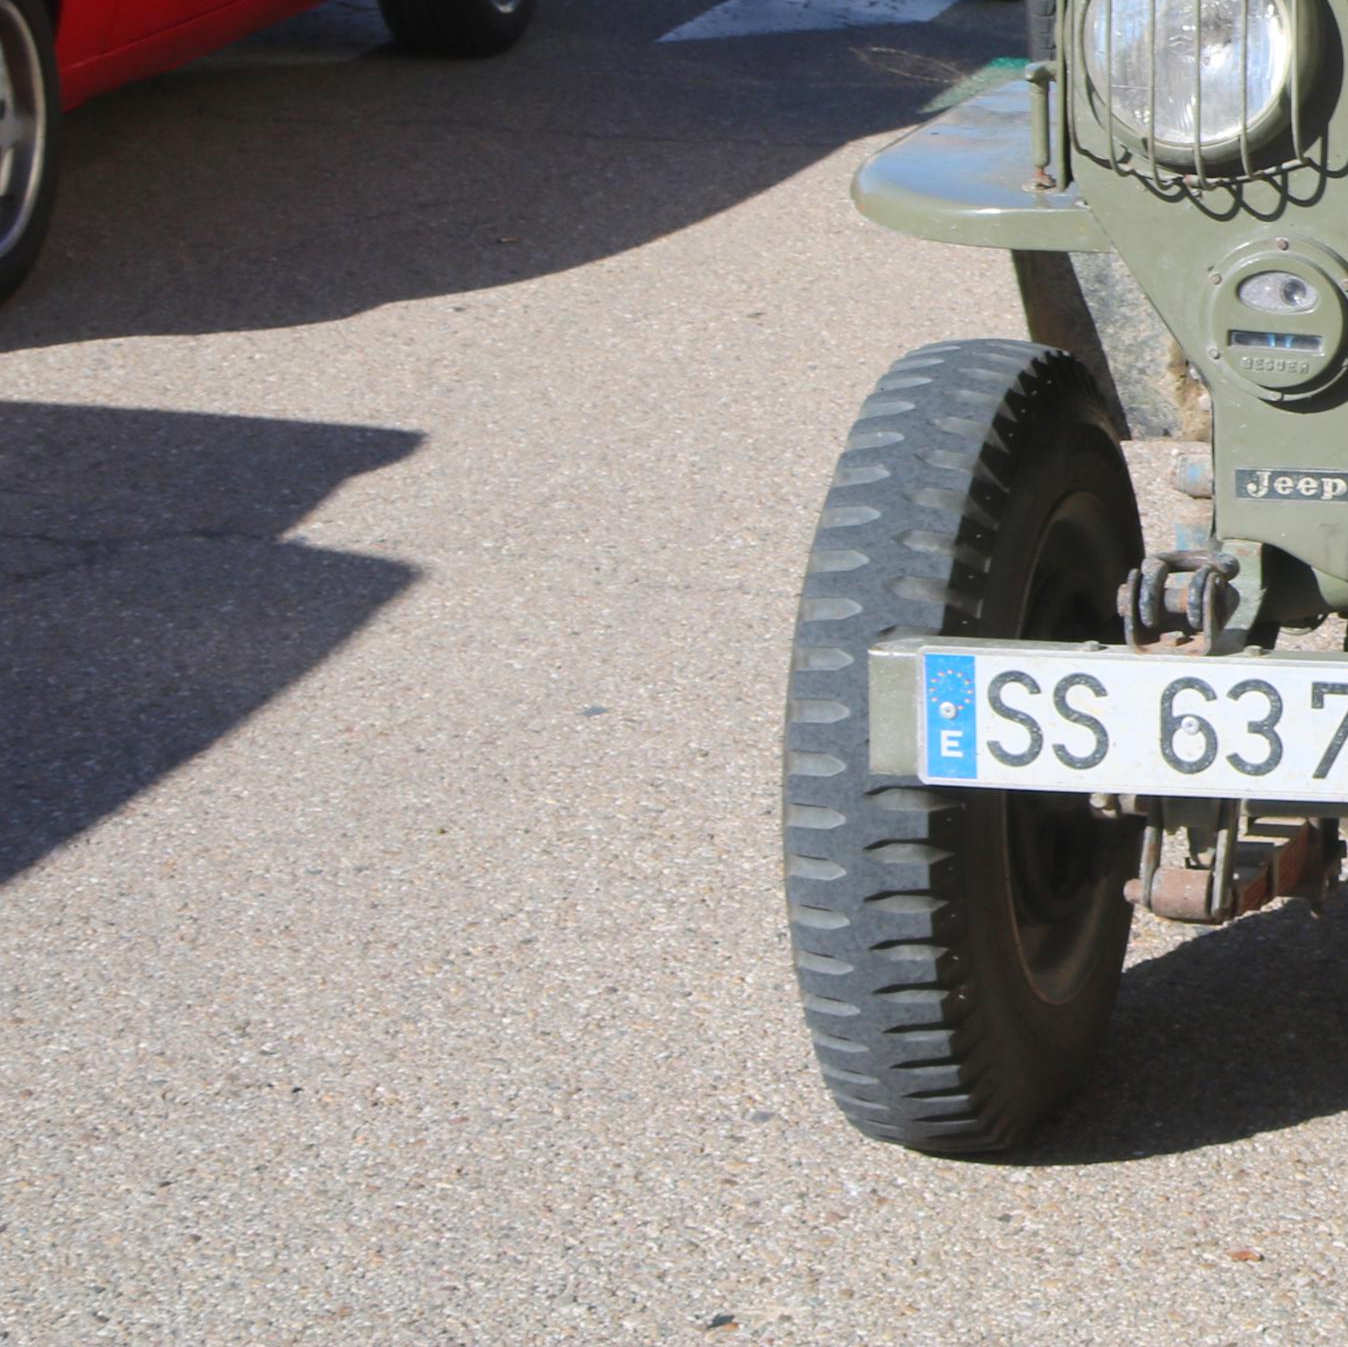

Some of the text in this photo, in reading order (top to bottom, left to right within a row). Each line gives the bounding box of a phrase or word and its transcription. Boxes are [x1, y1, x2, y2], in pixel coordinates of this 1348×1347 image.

[1246, 471, 1348, 500] Jeep
[986, 670, 1109, 770] SS
[941, 731, 963, 758] E
